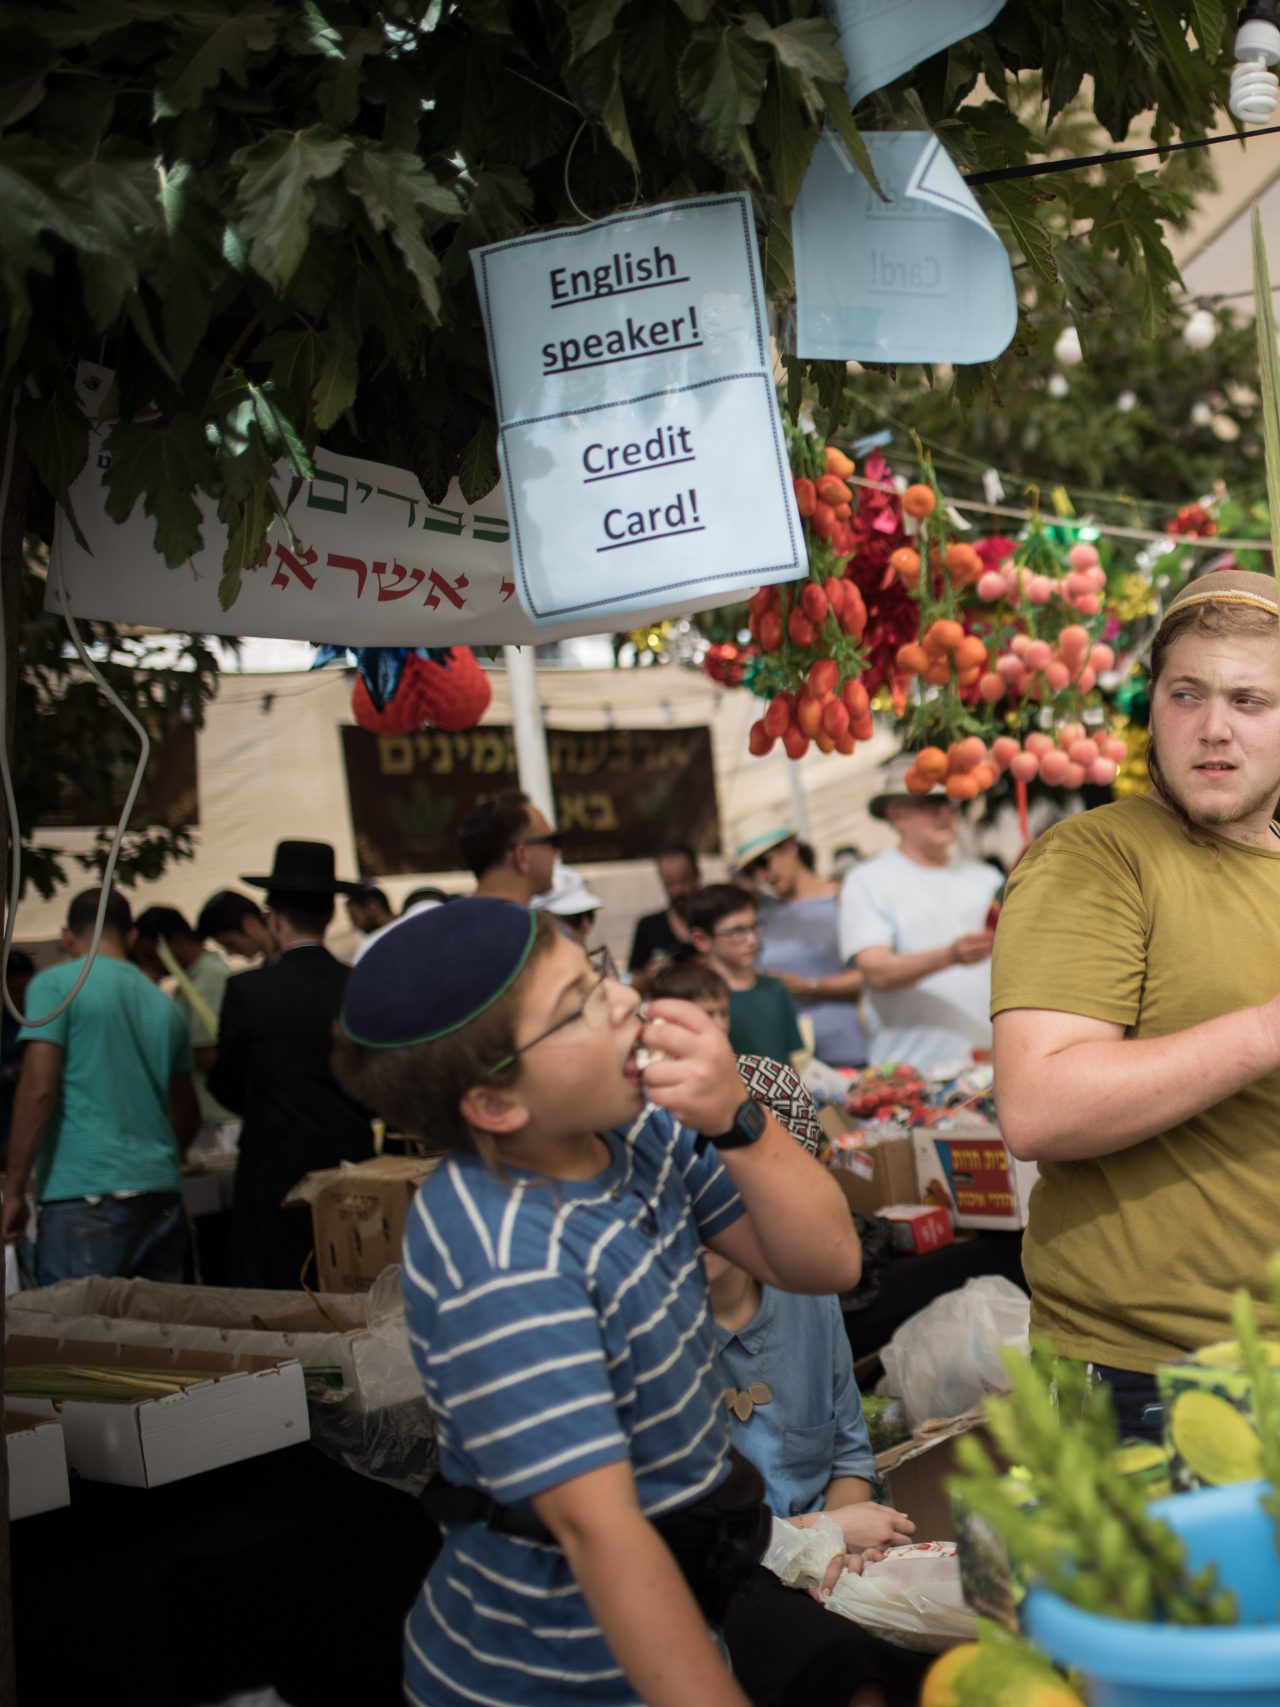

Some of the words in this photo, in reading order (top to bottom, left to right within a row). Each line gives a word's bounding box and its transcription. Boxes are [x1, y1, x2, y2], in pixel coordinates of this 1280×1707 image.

[549, 246, 677, 301] English
[541, 306, 700, 369] speaker!
[582, 425, 694, 475] Credit
[307, 469, 510, 543] כבדים
[603, 489, 700, 541] Card!
